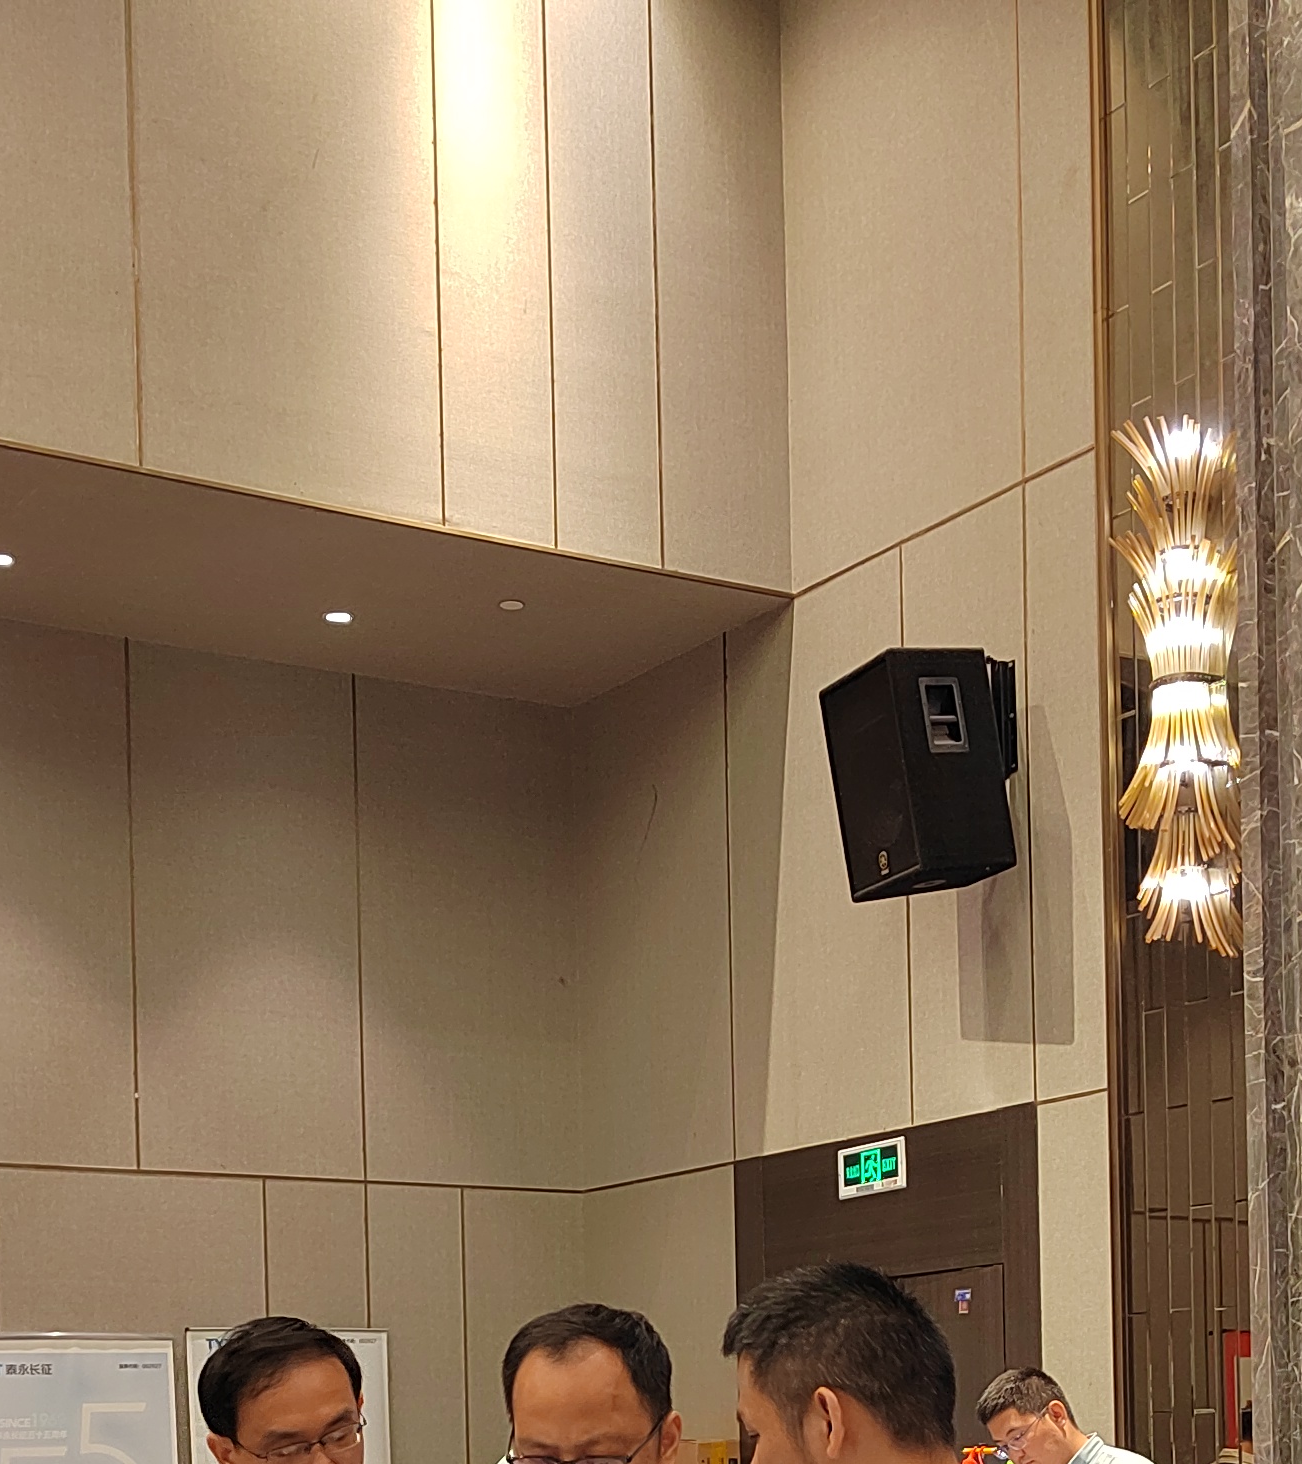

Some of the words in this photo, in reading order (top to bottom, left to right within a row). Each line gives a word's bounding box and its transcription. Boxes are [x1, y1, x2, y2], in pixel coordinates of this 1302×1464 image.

[882, 1157, 896, 1172] EXIT
[206, 1338, 229, 1350] TY
[5, 1364, 53, 1375] 泰永长征
